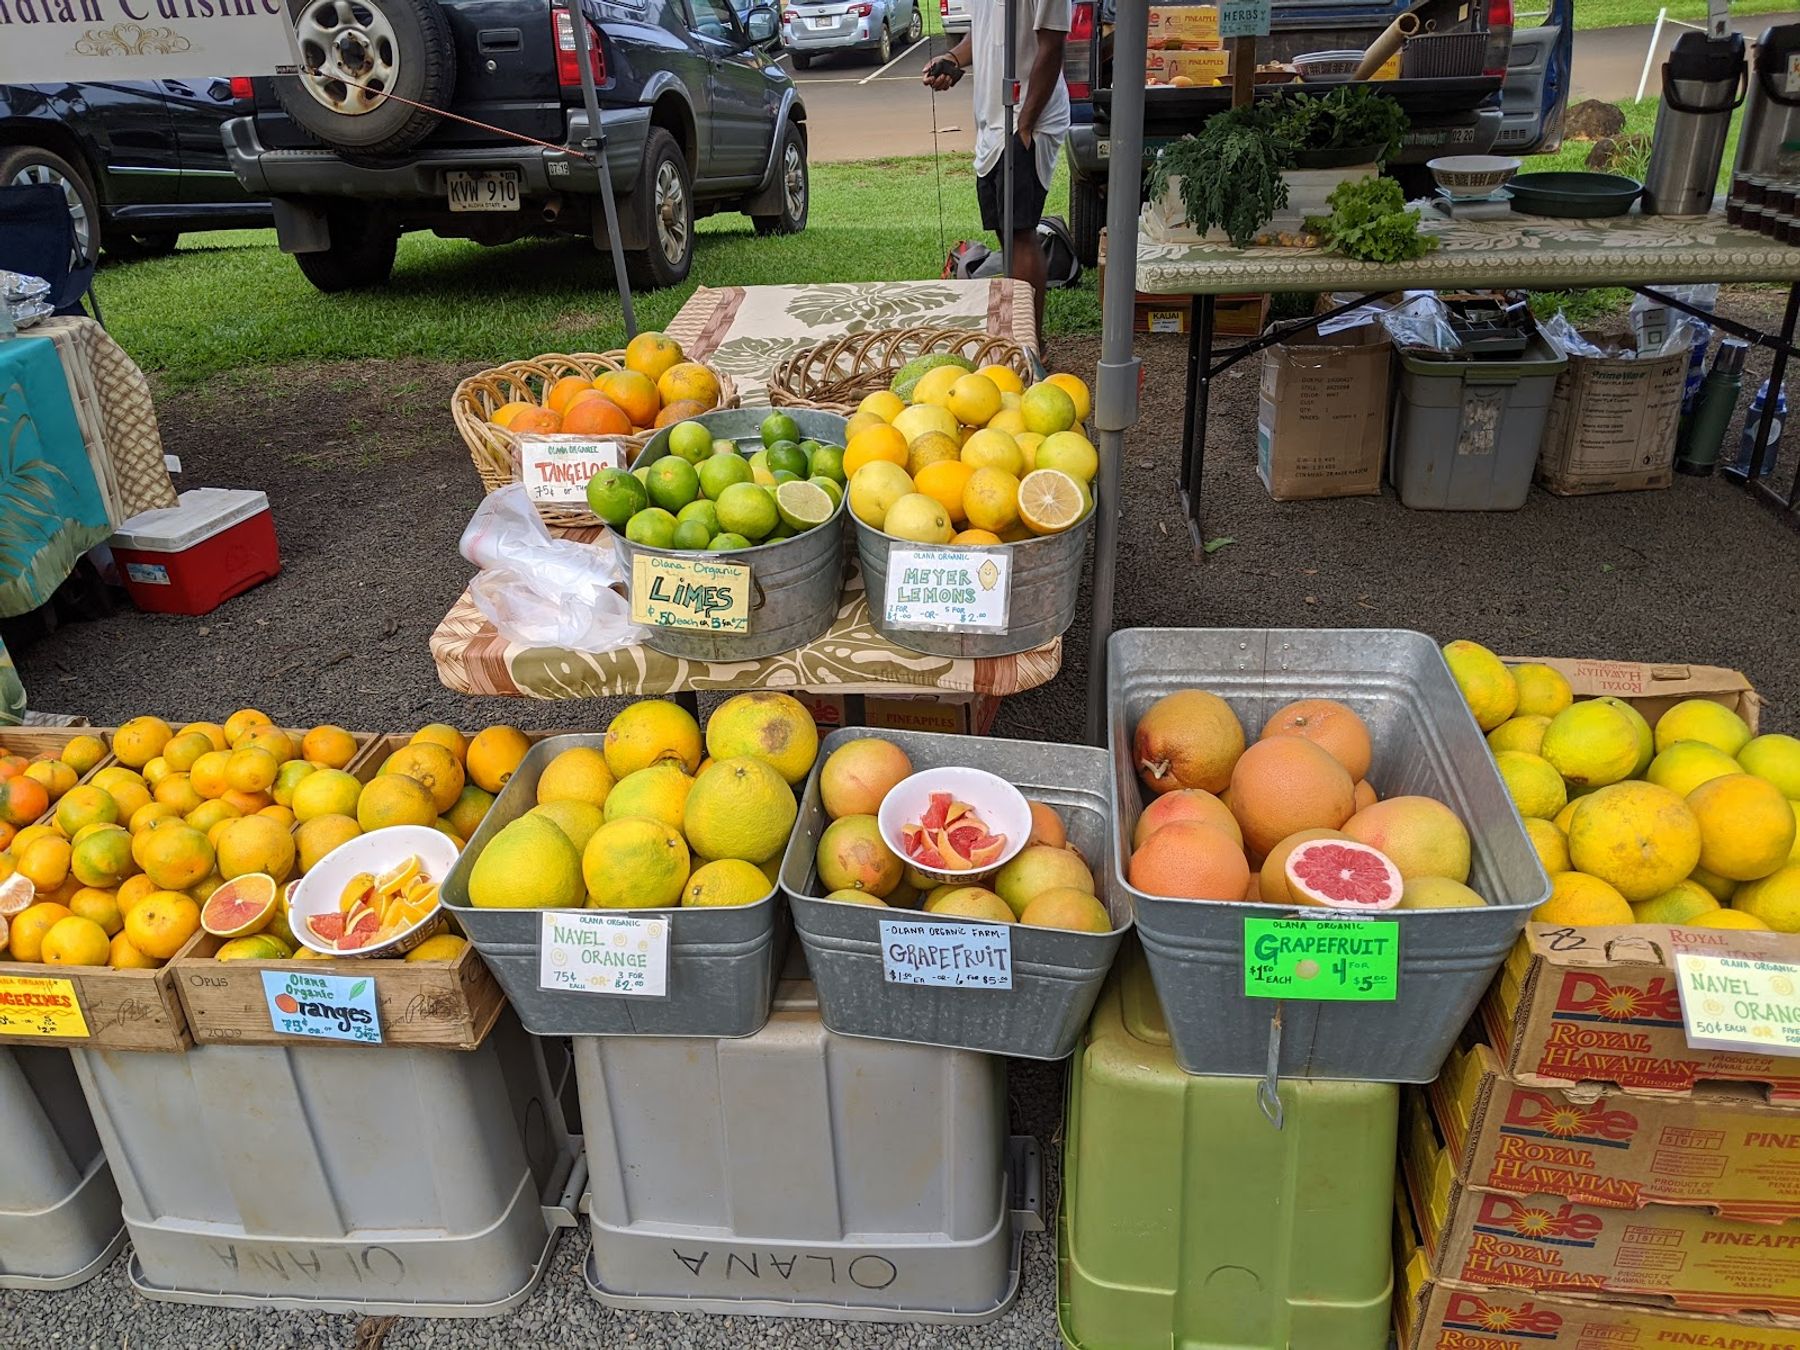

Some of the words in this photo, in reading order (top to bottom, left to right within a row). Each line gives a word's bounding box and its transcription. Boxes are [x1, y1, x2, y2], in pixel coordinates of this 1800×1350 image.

[1223, 10, 1258, 21] HERBS
[1188, 58, 1224, 66] PINEAPPLES
[450, 181, 478, 203] KVW
[487, 180, 516, 202] 910
[1153, 312, 1179, 320] KAUAI
[938, 553, 970, 561] ORGANIC
[651, 558, 685, 570] Olana
[693, 562, 742, 580] Organic
[903, 568, 972, 586] MEYER
[897, 586, 976, 604] LEMONS
[895, 605, 908, 613] FOR
[676, 618, 698, 627] each
[711, 617, 721, 629] 5
[1577, 668, 1642, 681] HAWAIIAN
[1602, 681, 1642, 693] ROYAL
[886, 712, 955, 728] PINEAPPLES
[579, 916, 604, 925] OLANA
[606, 917, 641, 927] ORGANIC
[1272, 921, 1308, 930] OLANA
[1316, 922, 1364, 930] ORGANIC
[554, 926, 605, 946] NAVEL
[1669, 928, 1728, 946] ROYAL
[1254, 933, 1389, 965] GRAPEFRUIT
[581, 949, 648, 968] ORANGE
[1720, 958, 1750, 968] OLANA
[1754, 962, 1797, 973] ORGANIC
[553, 970, 577, 982] 75¢
[617, 971, 624, 979] 3
[628, 971, 644, 979] FOR
[955, 973, 963, 985] 6
[1266, 975, 1292, 984] EACH
[1332, 958, 1346, 985] 4
[1348, 961, 1370, 969] FOR
[289, 974, 328, 988] Olana
[1691, 973, 1759, 996] NAVEL
[285, 984, 334, 1000] Organic
[1555, 971, 1683, 1020] Dole
[1696, 1021, 1722, 1034] 50¢
[1724, 1023, 1747, 1032] EACH
[1546, 1022, 1652, 1053] ROYAL
[1544, 1046, 1699, 1077] HAWAIIAN
[1504, 1089, 1639, 1139] Dole
[1696, 1138, 1703, 1146] 7
[1496, 1135, 1595, 1168] ROYAL
[1495, 1156, 1645, 1197] HAWAIIAN
[1654, 1177, 1698, 1187] PRODUCT
[1476, 1194, 1603, 1239] Dole
[1472, 1233, 1563, 1267] ROYAL
[209, 1244, 406, 1286] OLANA
[672, 1248, 897, 1290] OLANA
[1467, 1250, 1609, 1289] HAWAIIAN
[1617, 1271, 1659, 1279] PRODUCT
[1444, 1291, 1563, 1333] Dole
